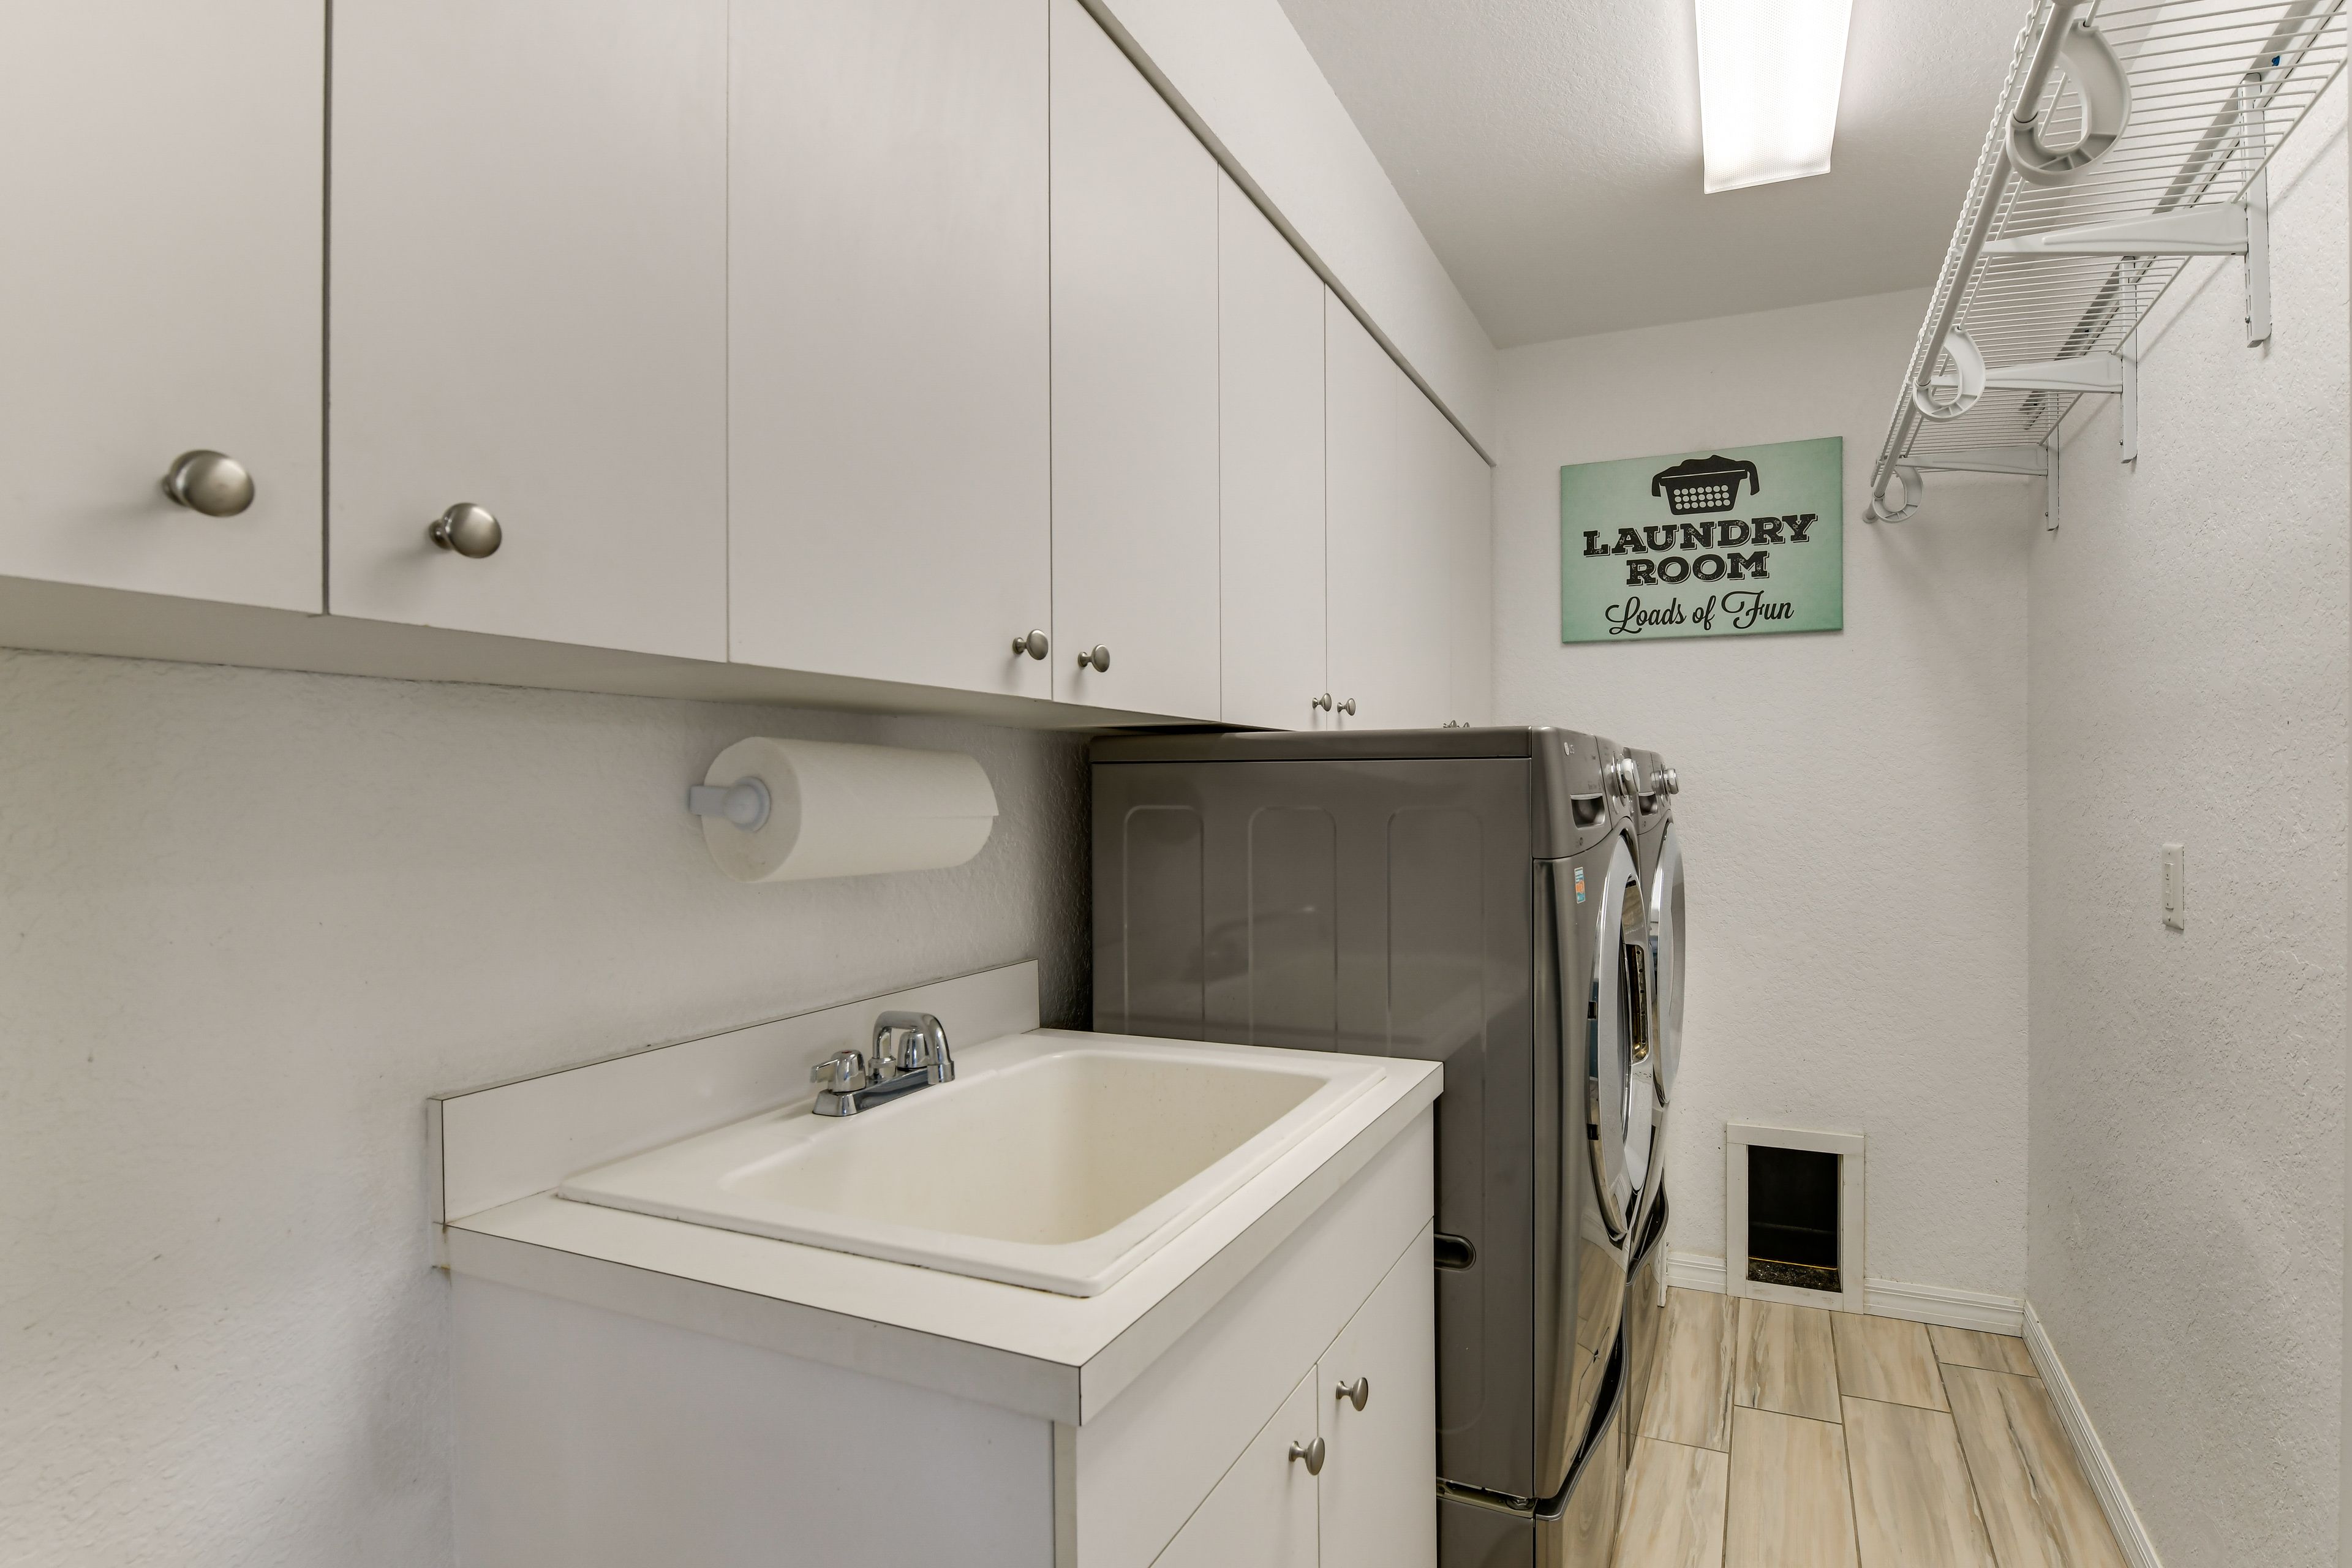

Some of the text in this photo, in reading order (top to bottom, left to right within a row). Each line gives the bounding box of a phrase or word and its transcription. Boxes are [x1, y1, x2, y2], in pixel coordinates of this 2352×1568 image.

[1583, 513, 1818, 557] LAUNDRY
[1626, 551, 1770, 586] ROOM
[1605, 590, 1795, 635] Loads of Fun
